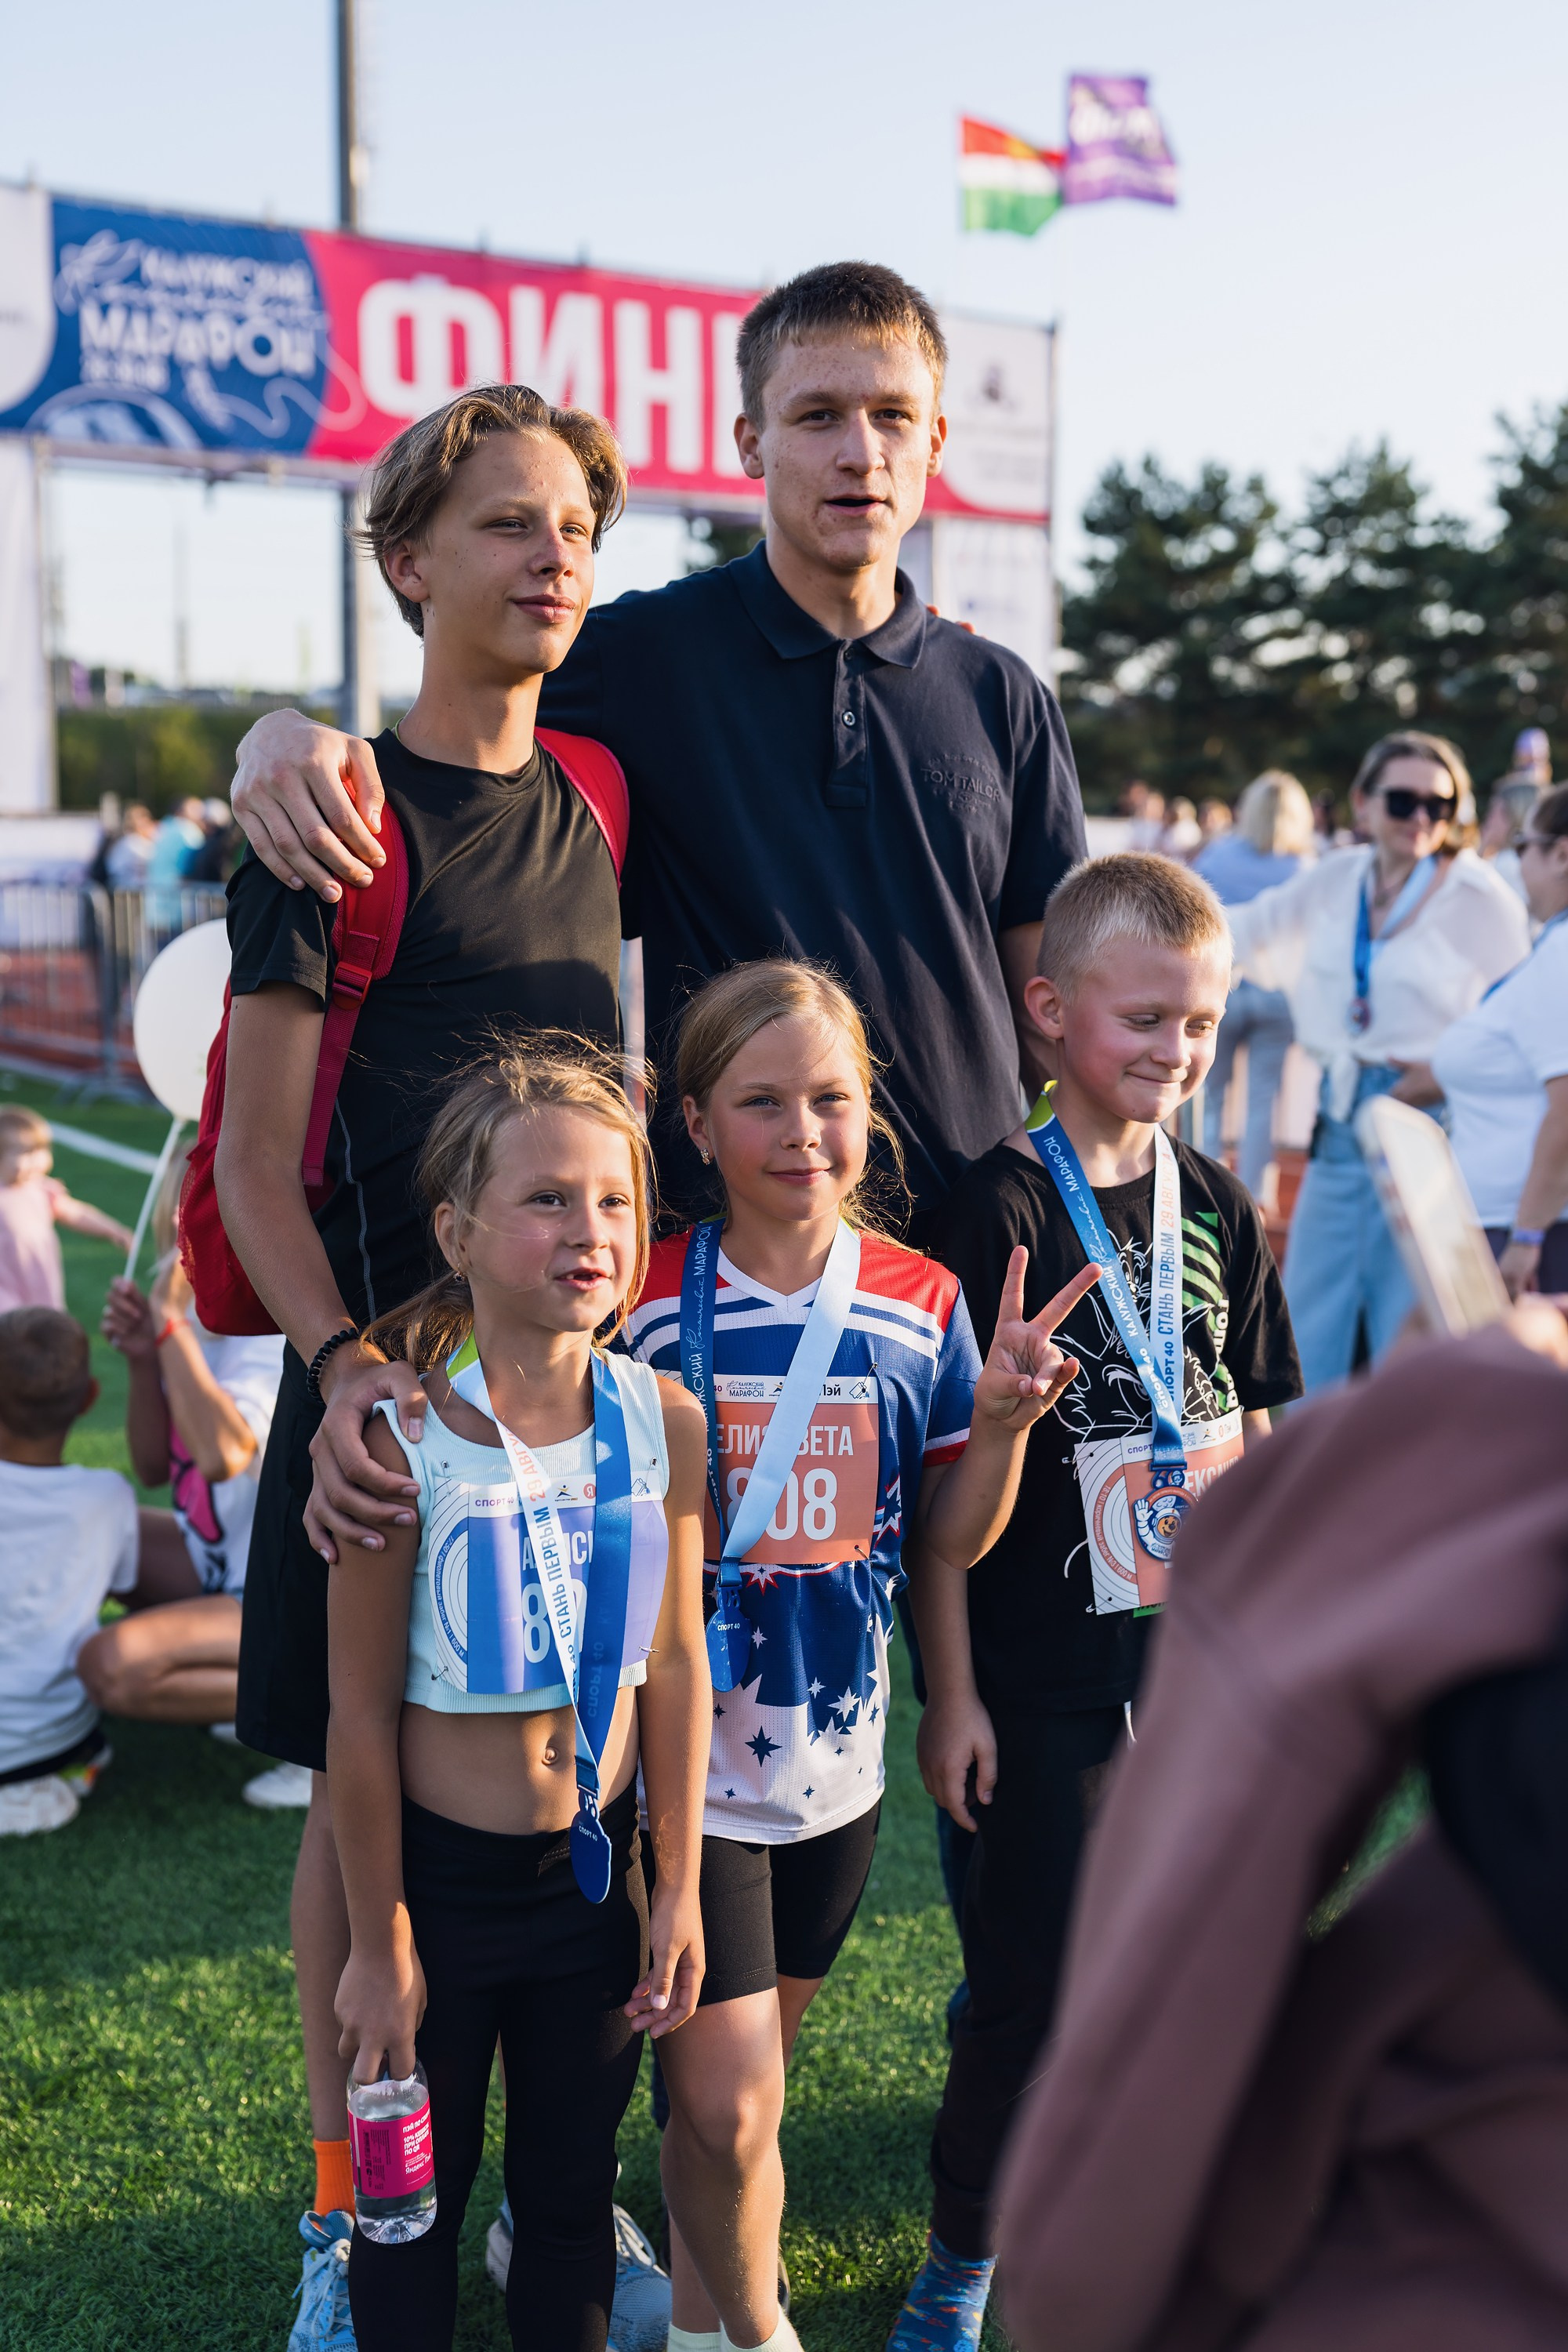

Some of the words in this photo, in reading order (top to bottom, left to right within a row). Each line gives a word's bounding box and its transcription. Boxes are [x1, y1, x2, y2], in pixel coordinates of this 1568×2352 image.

[358, 274, 741, 477] ФИН
[920, 768, 957, 788] TOM
[958, 775, 1001, 802] TAILOR
[1044, 1136, 1080, 1192] МАРАФОН
[1161, 1153, 1174, 1210] АВГУСТА
[1161, 1211, 1174, 1228] 29
[694, 1225, 713, 1276] МАРАФОН
[1159, 1232, 1175, 1292] ПЕРВЫМ
[1101, 1265, 1139, 1337] КАЛУЖСКИЙ
[1158, 1294, 1174, 1335] СТАНЬ
[1139, 1348, 1151, 1363] 40
[1164, 1341, 1174, 1357] 40
[729, 1389, 764, 1398] МАРАФОН
[1147, 1365, 1169, 1409] СПОРТ
[717, 1424, 854, 1456] ЕЛИВЕТА
[474, 1497, 506, 1507] СПОРТ
[528, 1479, 546, 1502] 29
[533, 1506, 563, 1582] ПЕРВЫМ
[1098, 1541, 1109, 1557] забег
[1116, 1567, 1127, 1577] 600
[438, 1601, 447, 1621] забег
[451, 1637, 461, 1652] 600
[552, 1584, 572, 1639] СТАНЬ
[579, 1825, 592, 1838] СПОРТ
[405, 2140, 416, 2151] ПРИ
[405, 2147, 413, 2156] ПО
[405, 2161, 424, 2175] Яндекс
